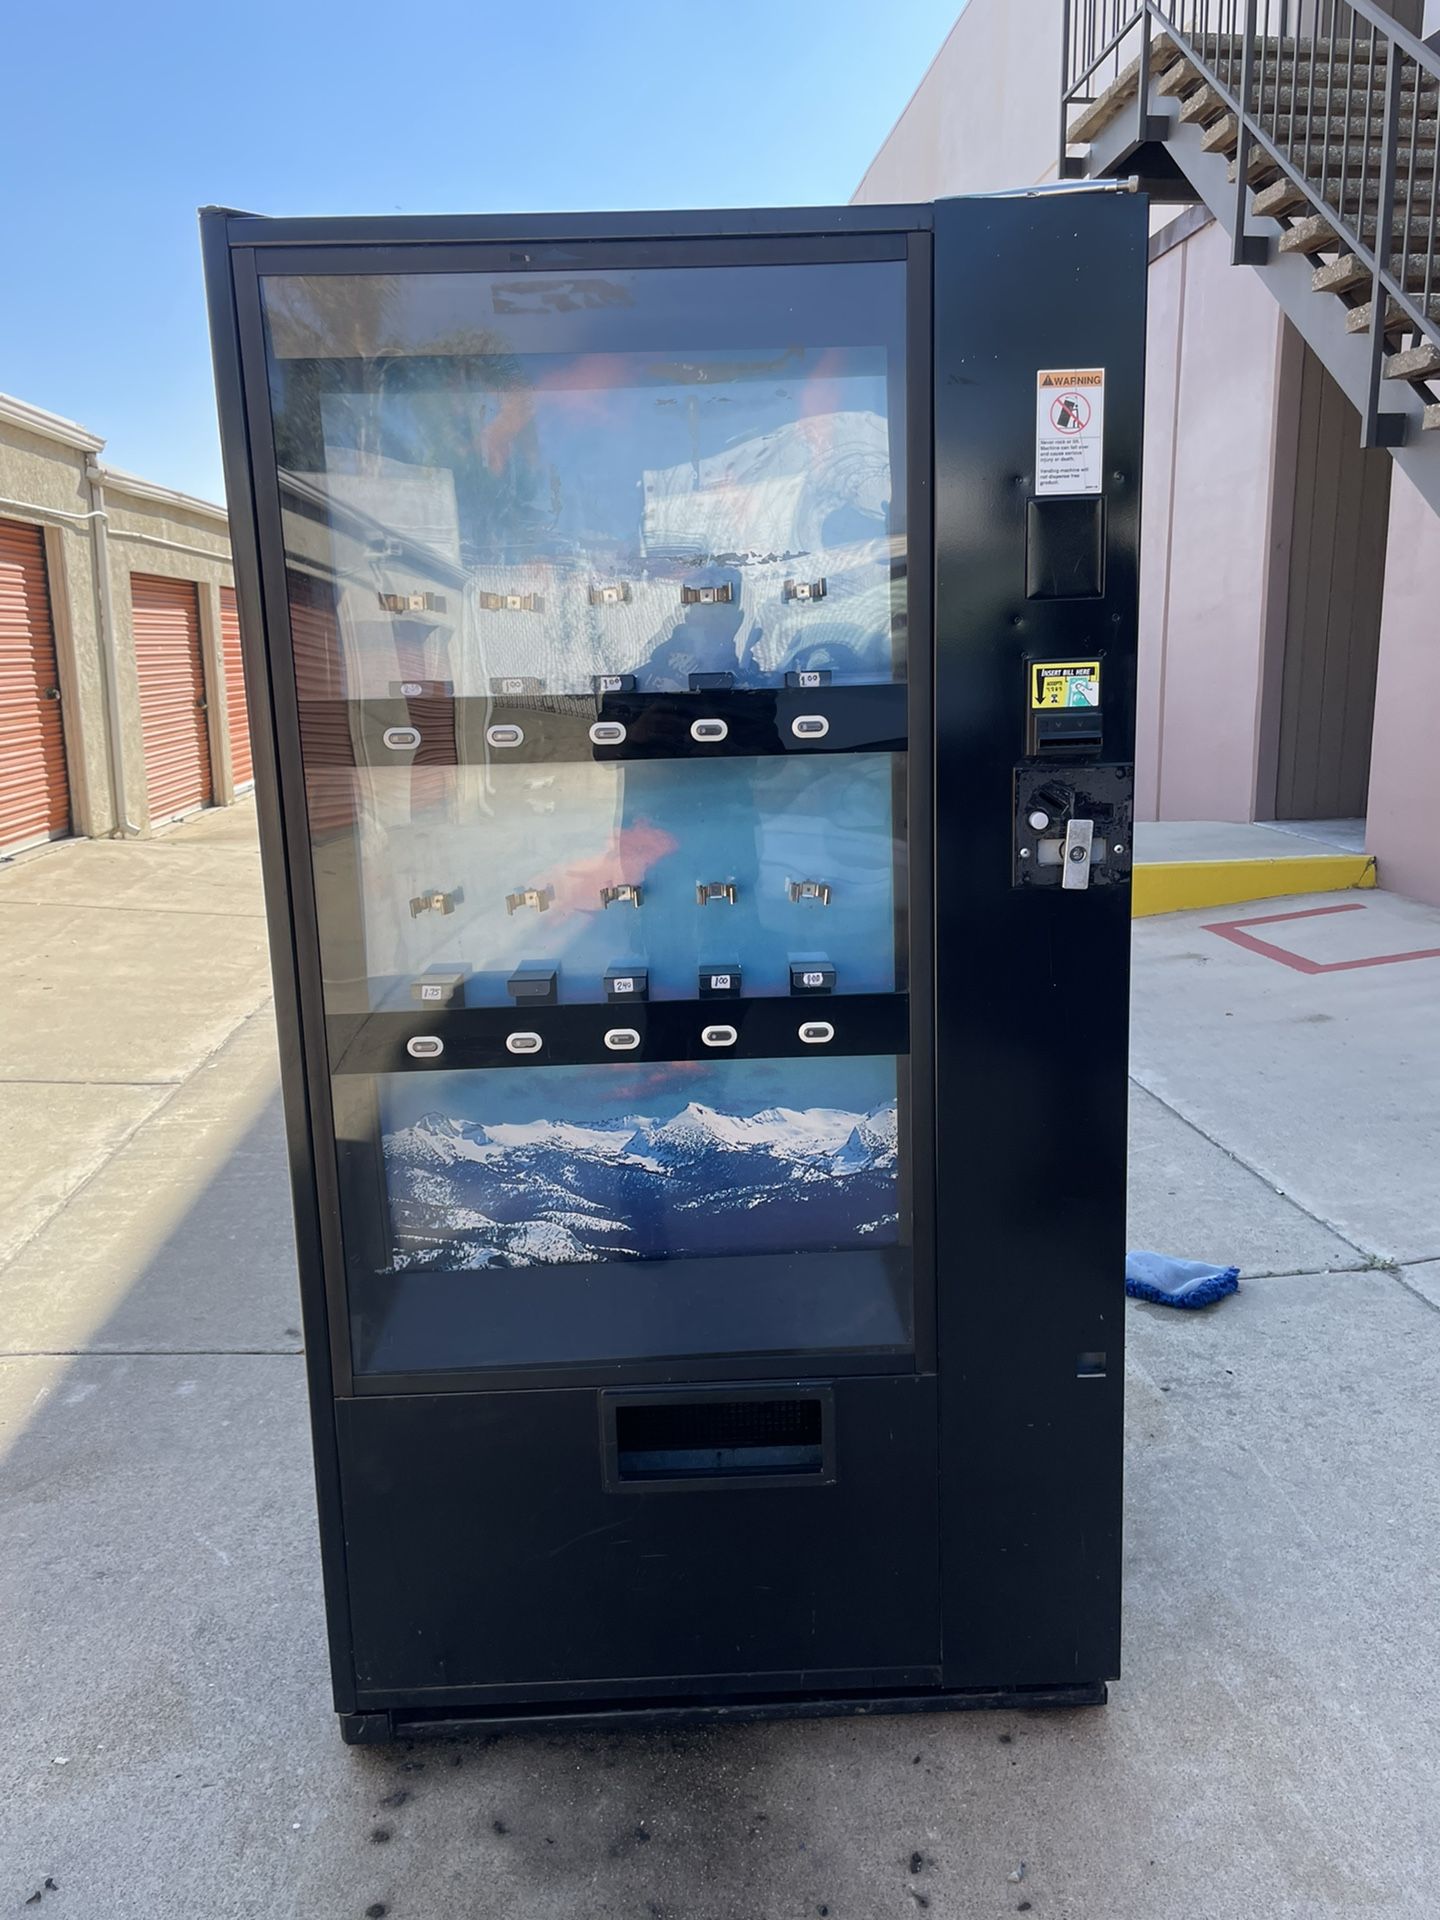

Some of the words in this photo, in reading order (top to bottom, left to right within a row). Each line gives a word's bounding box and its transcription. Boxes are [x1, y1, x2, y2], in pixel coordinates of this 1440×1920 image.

[1054, 375, 1101, 386] WARNING
[1041, 669, 1061, 677] INSERT
[1062, 668, 1075, 676] BILL
